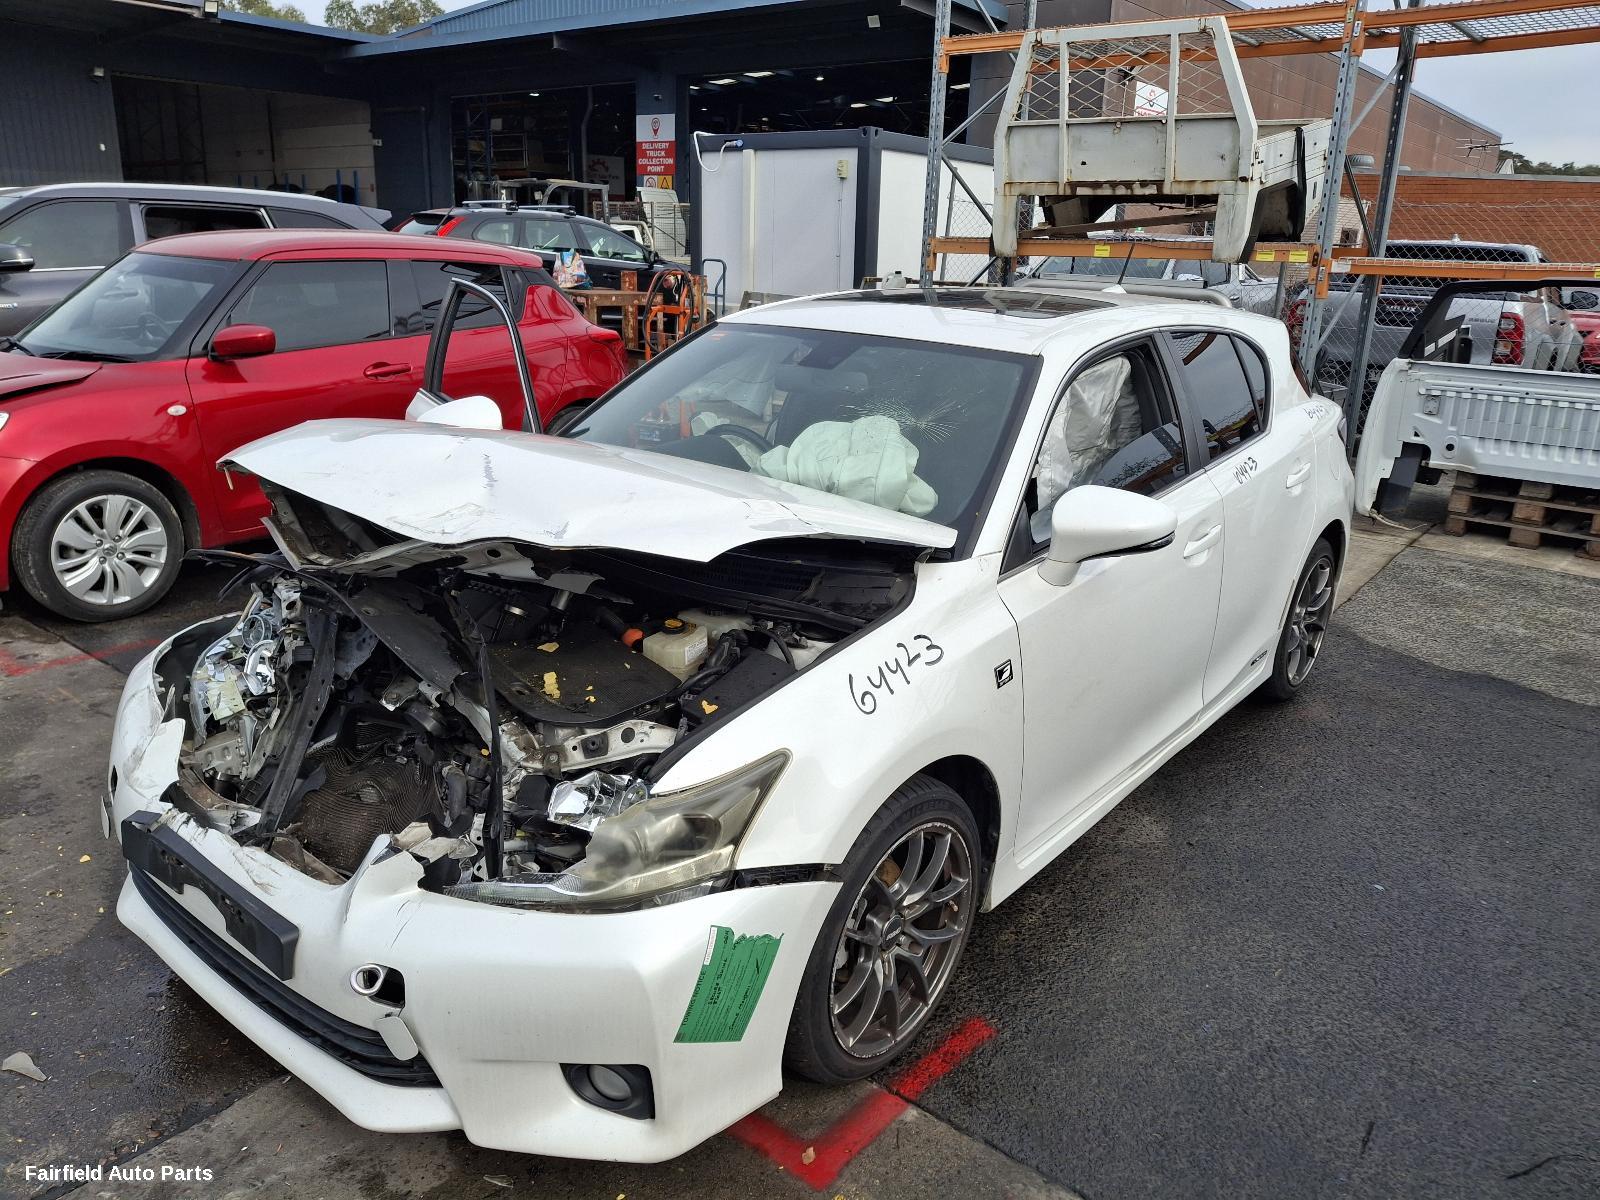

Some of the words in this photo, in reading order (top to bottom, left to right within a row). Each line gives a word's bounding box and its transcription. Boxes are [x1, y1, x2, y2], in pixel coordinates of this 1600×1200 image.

[642, 142, 669, 150] DELIVERY
[848, 634, 944, 715] 64423
[682, 998, 696, 1026] TOWING
[693, 970, 706, 998] NOTICE
